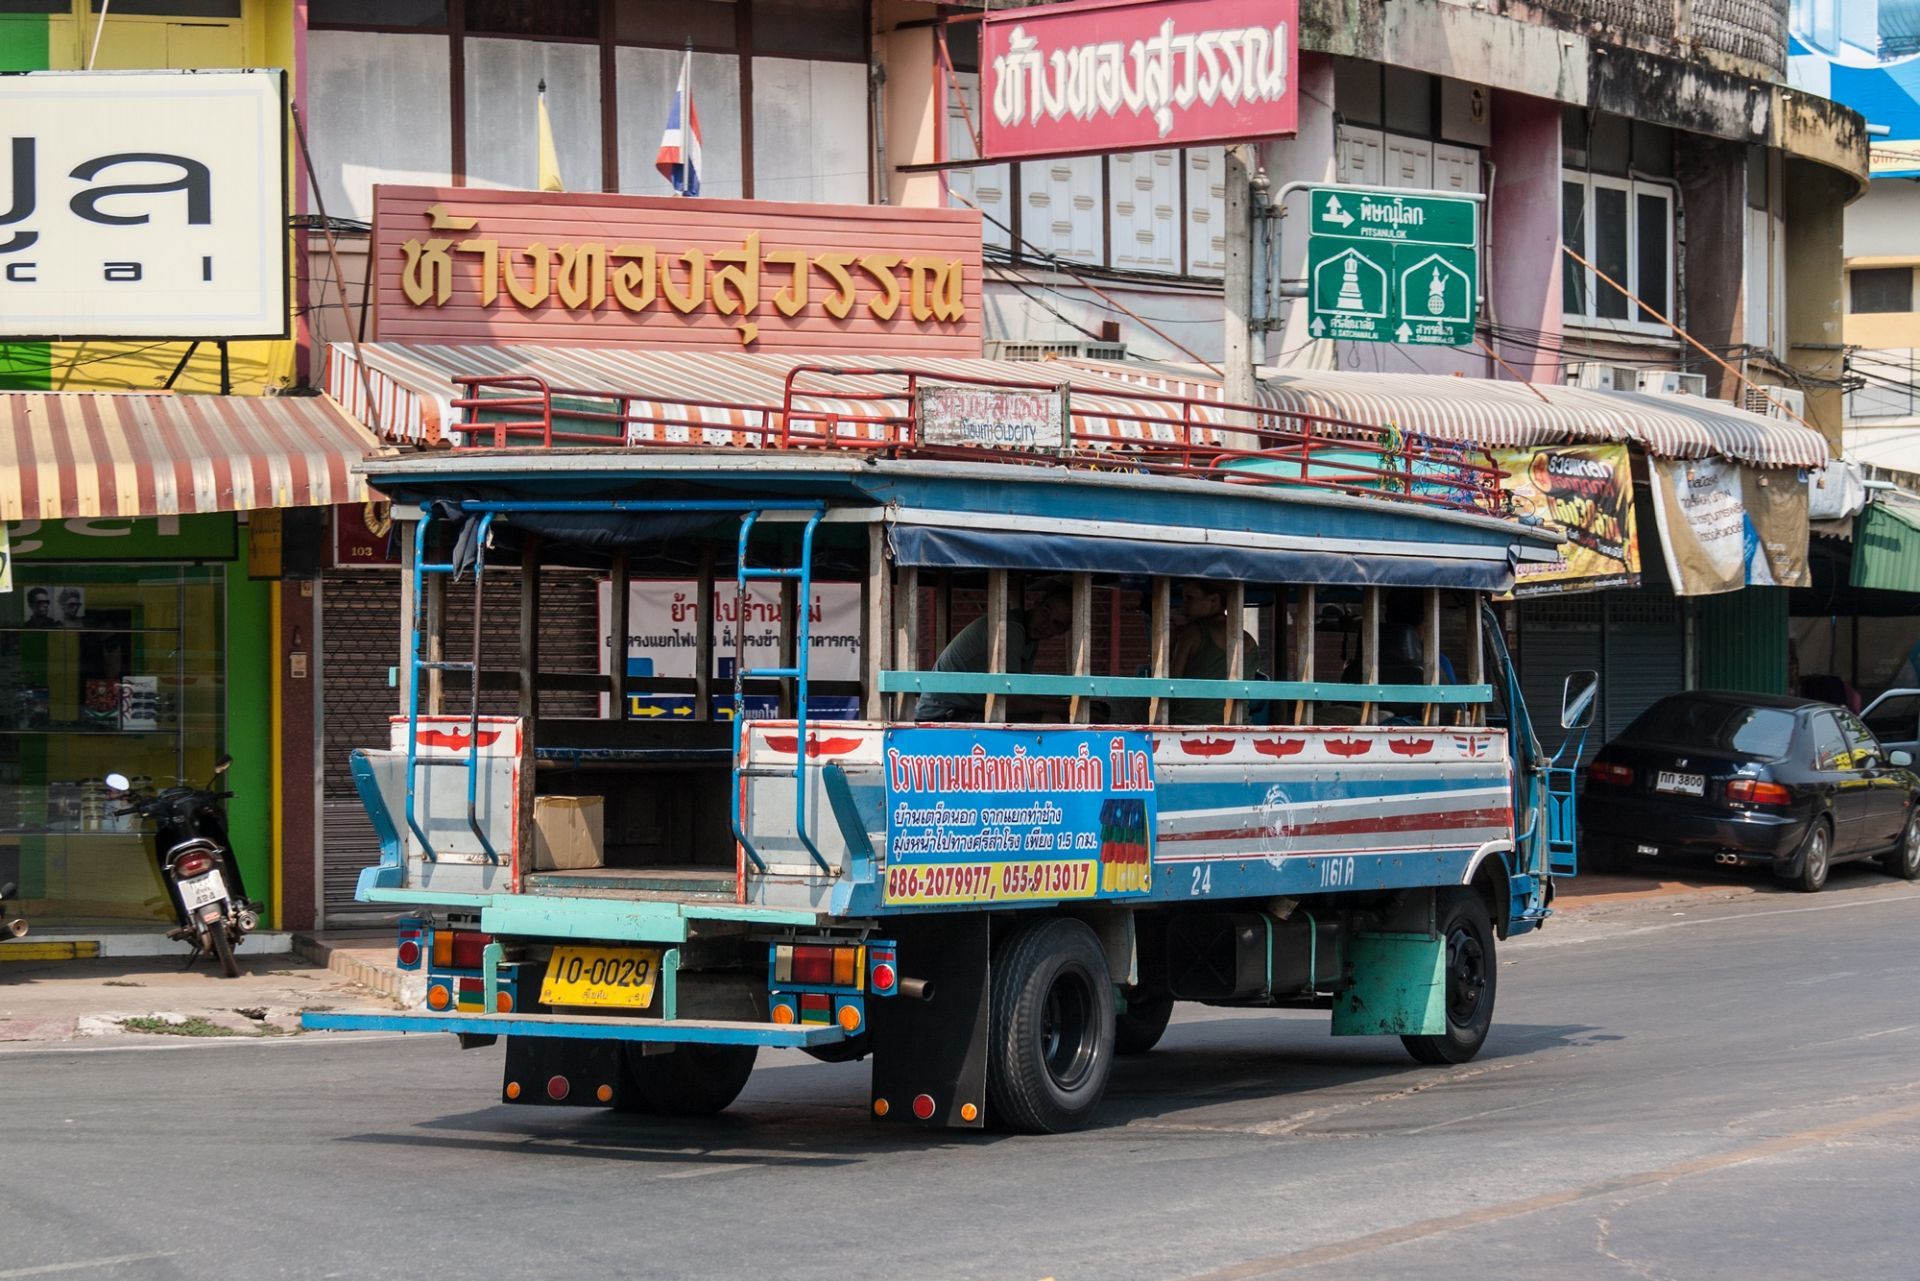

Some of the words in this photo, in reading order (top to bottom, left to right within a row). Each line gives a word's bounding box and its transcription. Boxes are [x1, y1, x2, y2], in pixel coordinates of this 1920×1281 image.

[993, 17, 1288, 139] ห้างทองสุวรรณ
[1359, 196, 1424, 230] พิษณุโลก
[401, 203, 965, 345] ห้างทองสุวรรณ
[351, 546, 373, 557] 103
[887, 744, 1103, 793] โรงงานผลิตหลังคาเหล็ก
[1678, 774, 1703, 787] 3800
[982, 800, 1062, 827] จากแยกท่าช้าง
[893, 825, 1021, 861] มุ่งหน้าไปทางศรีสำโรง
[1025, 829, 1053, 851] เพียง
[1057, 832, 1072, 849] 1.5
[1075, 833, 1098, 849] กม.
[888, 865, 997, 900] 086-2079977,
[1002, 862, 1091, 896] 055-913017
[1190, 864, 1212, 896] 24
[554, 956, 650, 987] 10-0029
